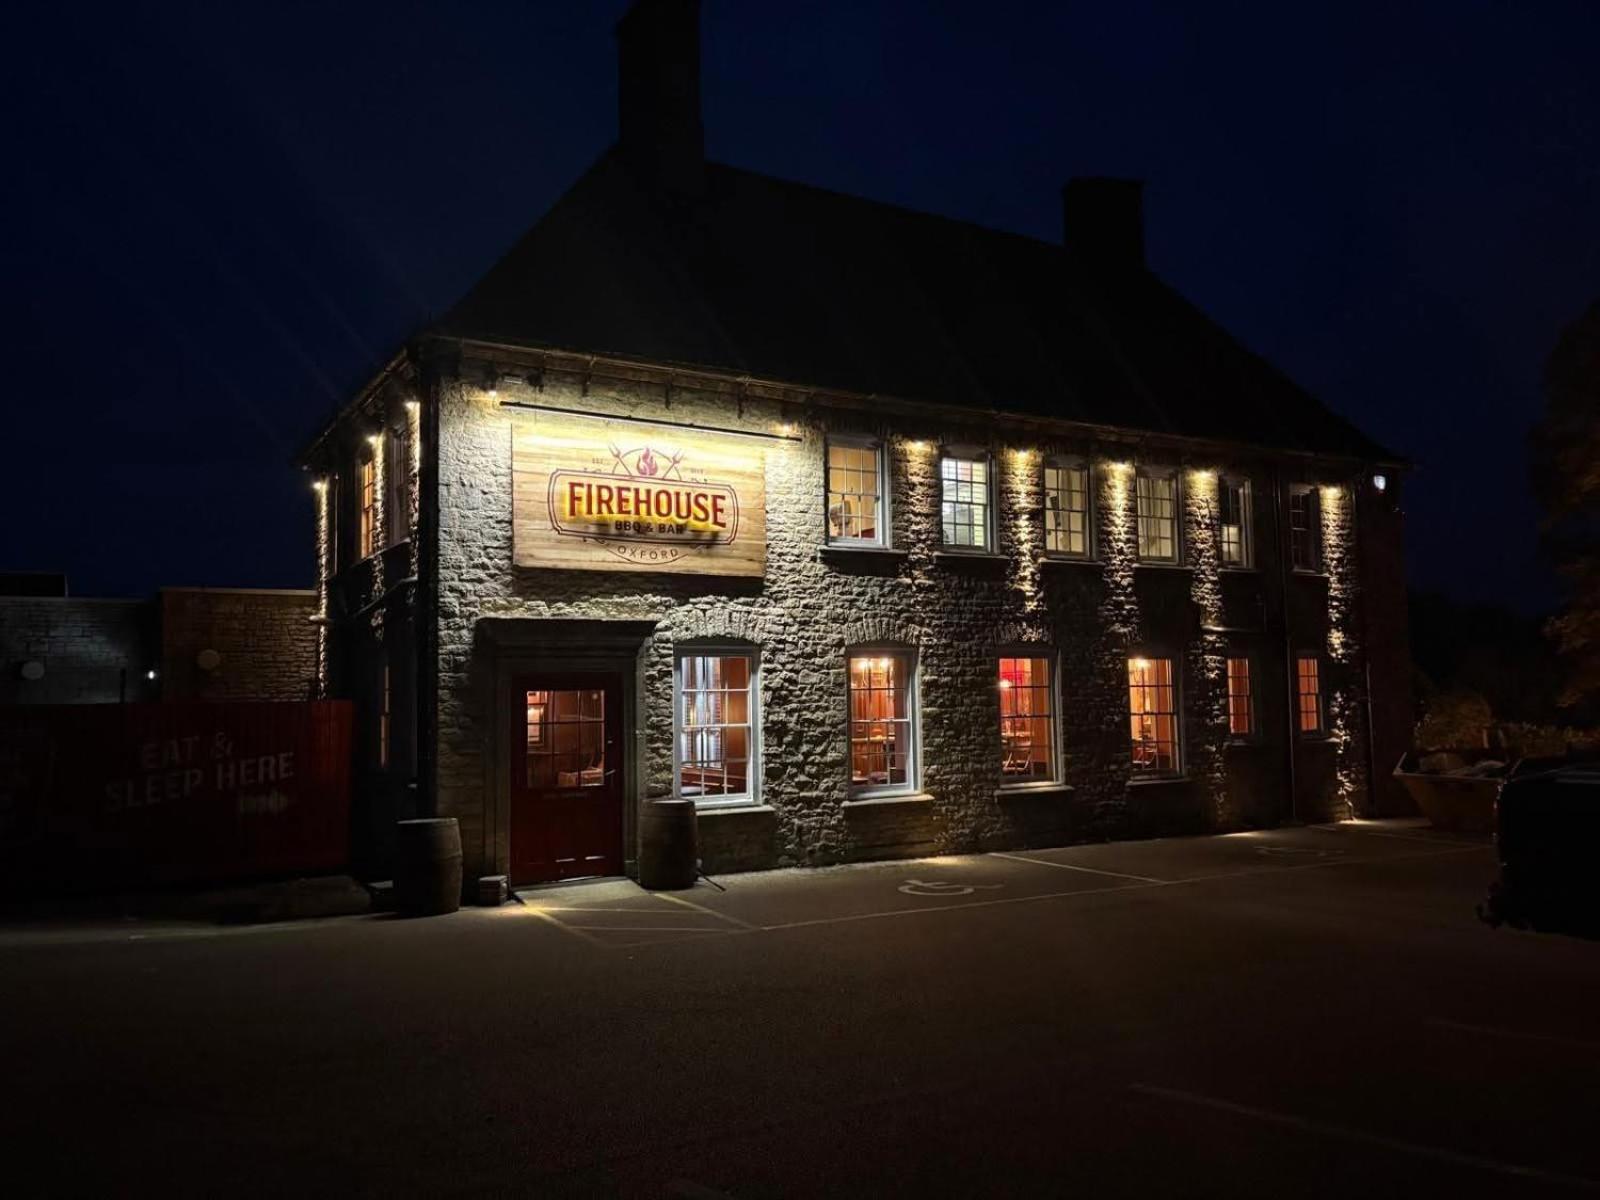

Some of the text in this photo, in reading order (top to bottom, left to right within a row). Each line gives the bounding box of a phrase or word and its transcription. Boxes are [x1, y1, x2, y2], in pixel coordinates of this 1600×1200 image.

[568, 481, 726, 528] FIREHOUSE
[615, 520, 684, 535] BBQ & BAR
[617, 545, 679, 560] OXFORD
[141, 731, 234, 769] EAT &
[105, 768, 204, 814] SLEEP
[217, 751, 295, 791] HERE
